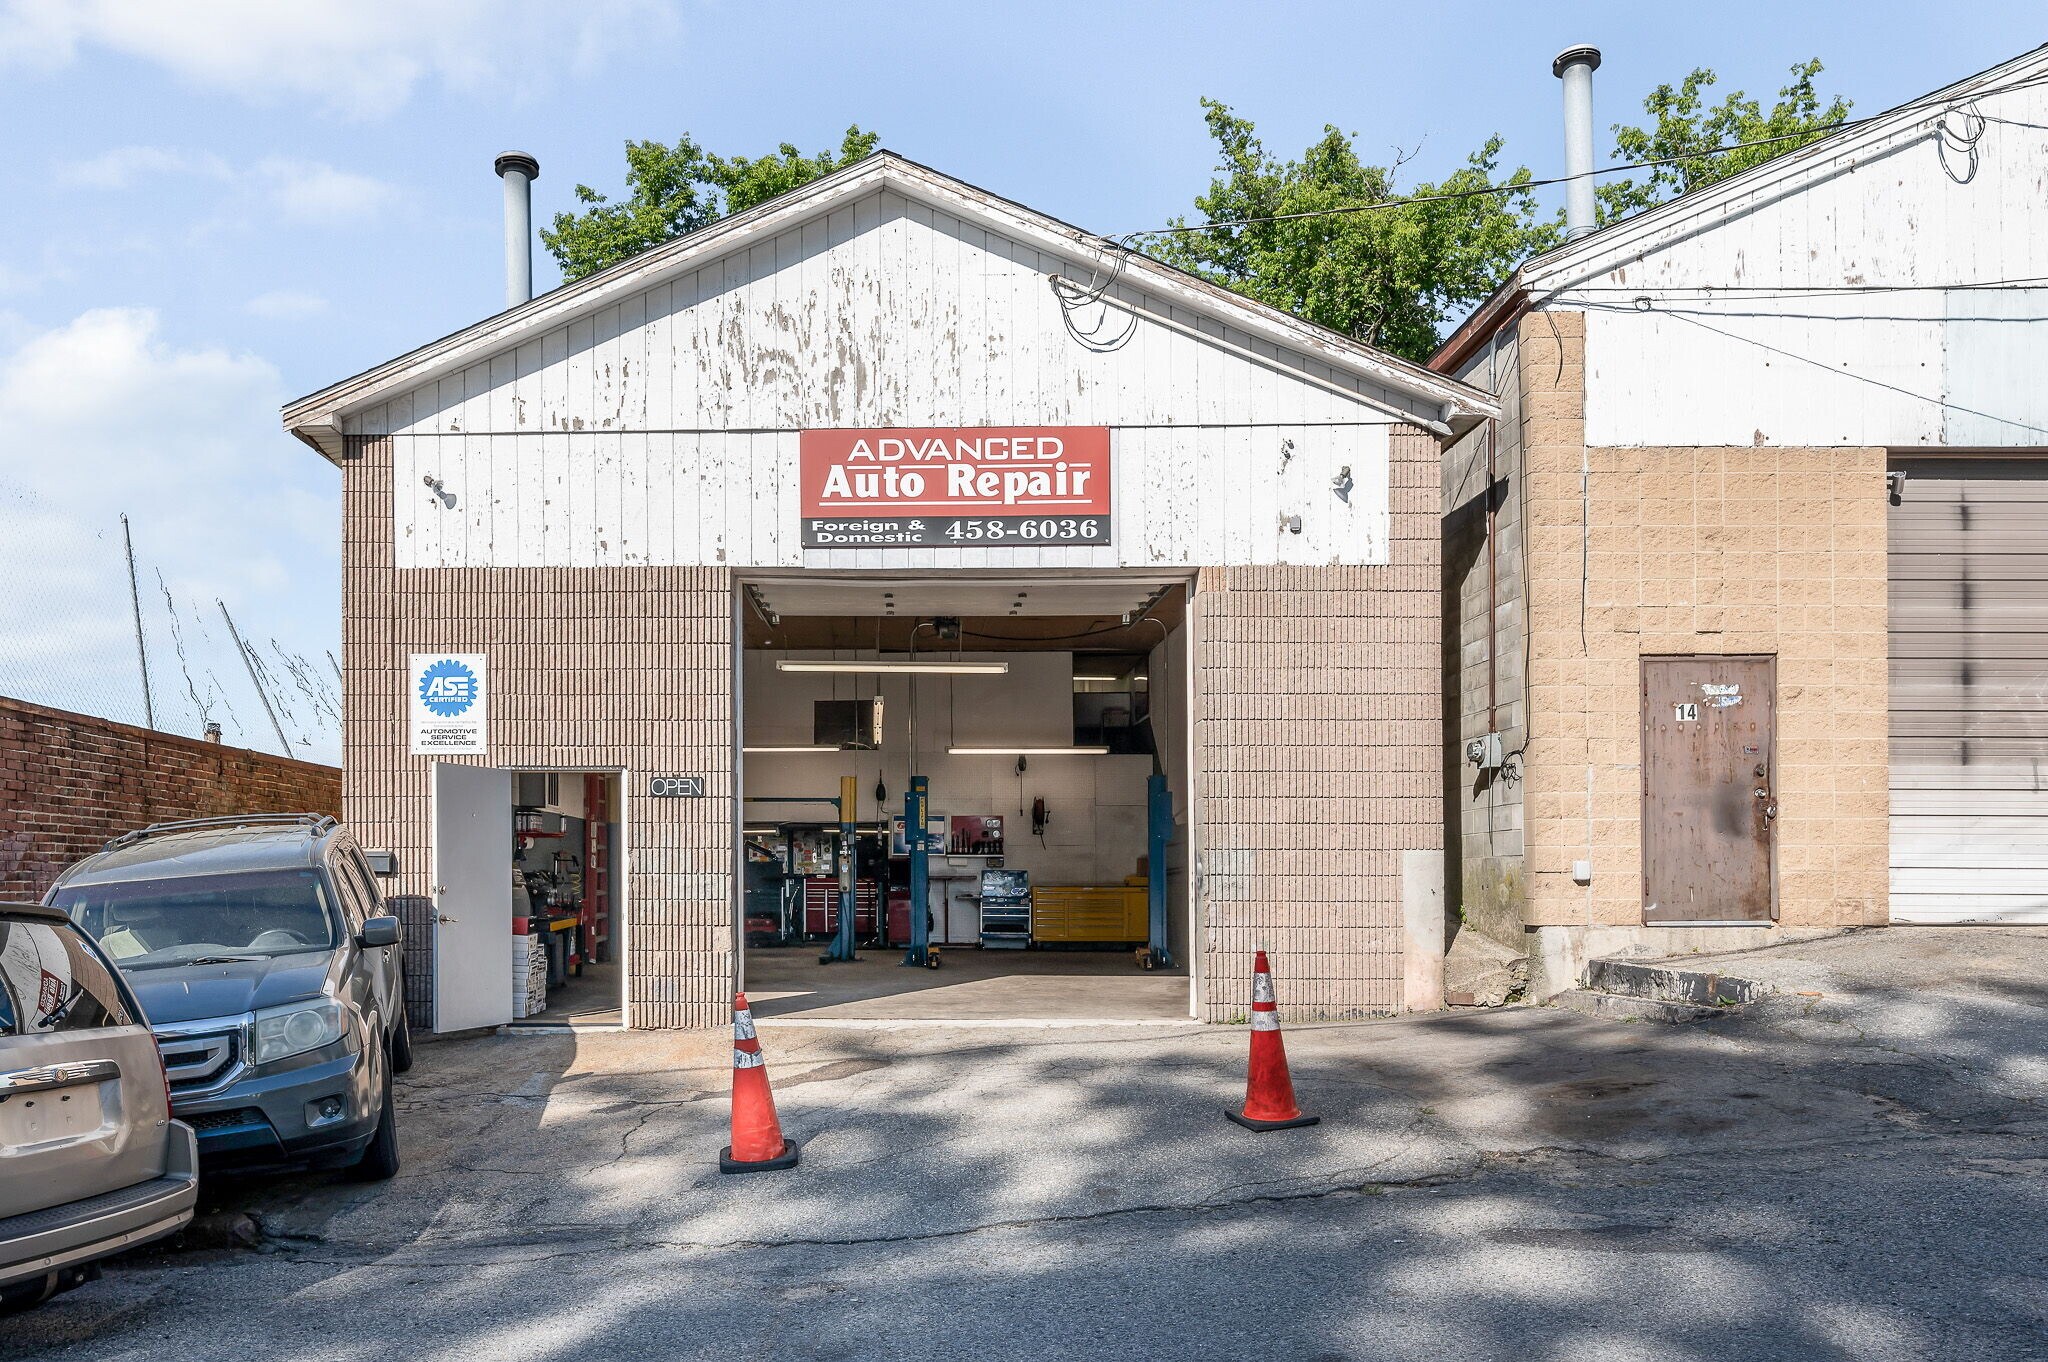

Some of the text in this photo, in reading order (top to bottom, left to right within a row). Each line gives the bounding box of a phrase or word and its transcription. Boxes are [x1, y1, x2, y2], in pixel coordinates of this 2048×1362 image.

[847, 437, 1064, 462] ADVANCED
[821, 461, 1091, 504] Auto Repair
[811, 520, 926, 532] Foreign &
[945, 519, 1098, 540] 458-6036
[816, 532, 923, 543] Domestic
[426, 677, 468, 696] ASE
[1679, 705, 1696, 719] 14
[651, 778, 702, 795] OPEN
